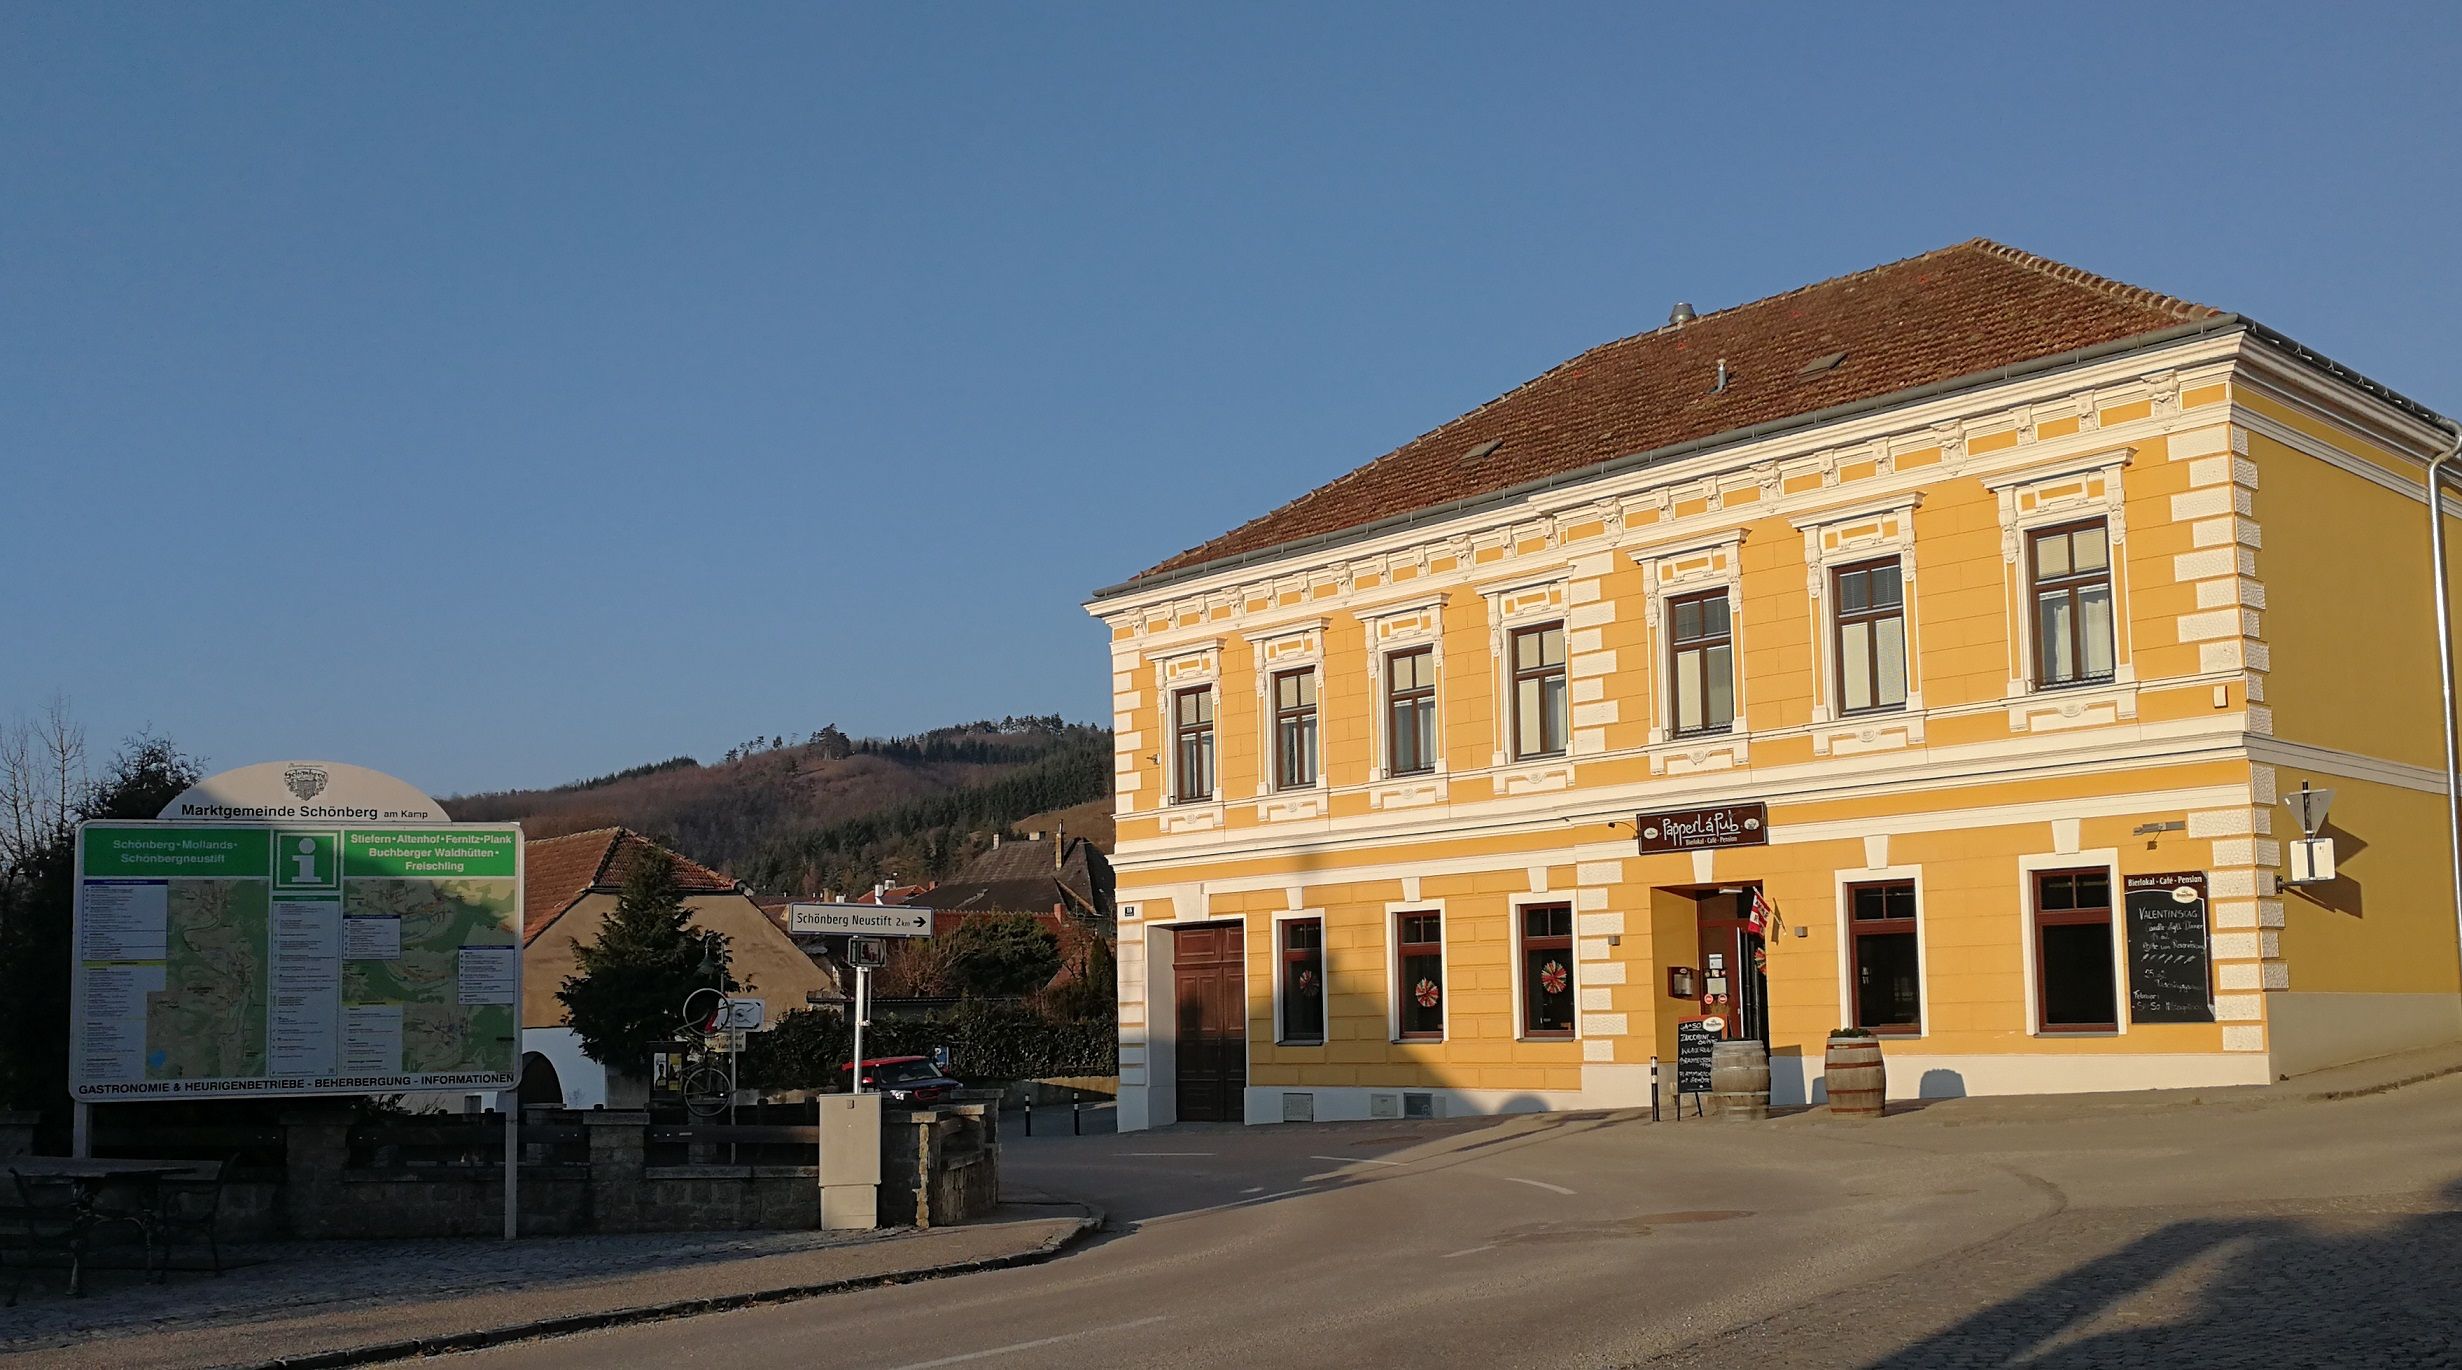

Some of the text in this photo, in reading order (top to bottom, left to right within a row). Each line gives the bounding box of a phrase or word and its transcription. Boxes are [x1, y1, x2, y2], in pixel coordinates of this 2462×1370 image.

[181, 804, 296, 818] Marktgemeinde
[300, 805, 378, 820] Schönberg
[401, 810, 428, 819] Kamp
[369, 848, 432, 858] Buchberger
[405, 861, 465, 872] Freischling
[2128, 875, 2202, 887] Bierlokal Café Pension
[797, 912, 849, 928] Schönberg
[852, 914, 892, 927] Neustift
[78, 1083, 169, 1095] GASTRONOMIE
[173, 1082, 181, 1092] &
[185, 1079, 304, 1092] HEURIGENBETRIEBE
[314, 1077, 411, 1088] BEHERBERGUNG
[421, 1073, 514, 1085] INFORMATIONEN
